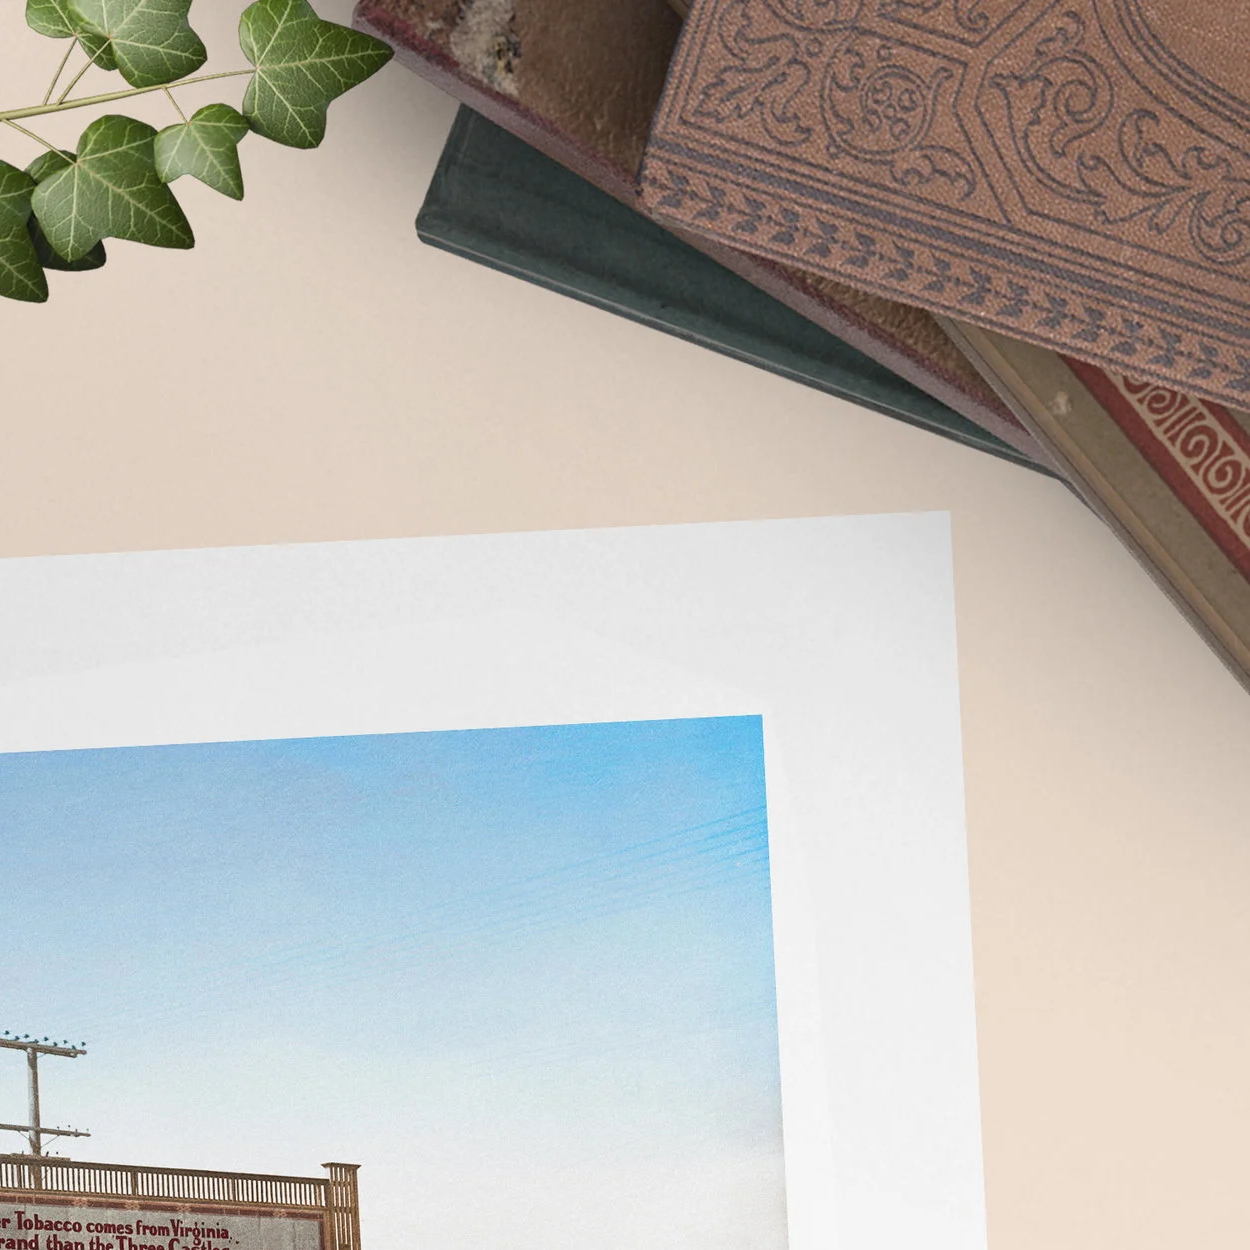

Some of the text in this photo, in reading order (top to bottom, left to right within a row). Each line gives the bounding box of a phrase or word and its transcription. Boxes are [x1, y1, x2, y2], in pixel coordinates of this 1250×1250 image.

[14, 1211, 82, 1232] Tobacco
[86, 1221, 134, 1235] comes
[136, 1219, 170, 1237] from
